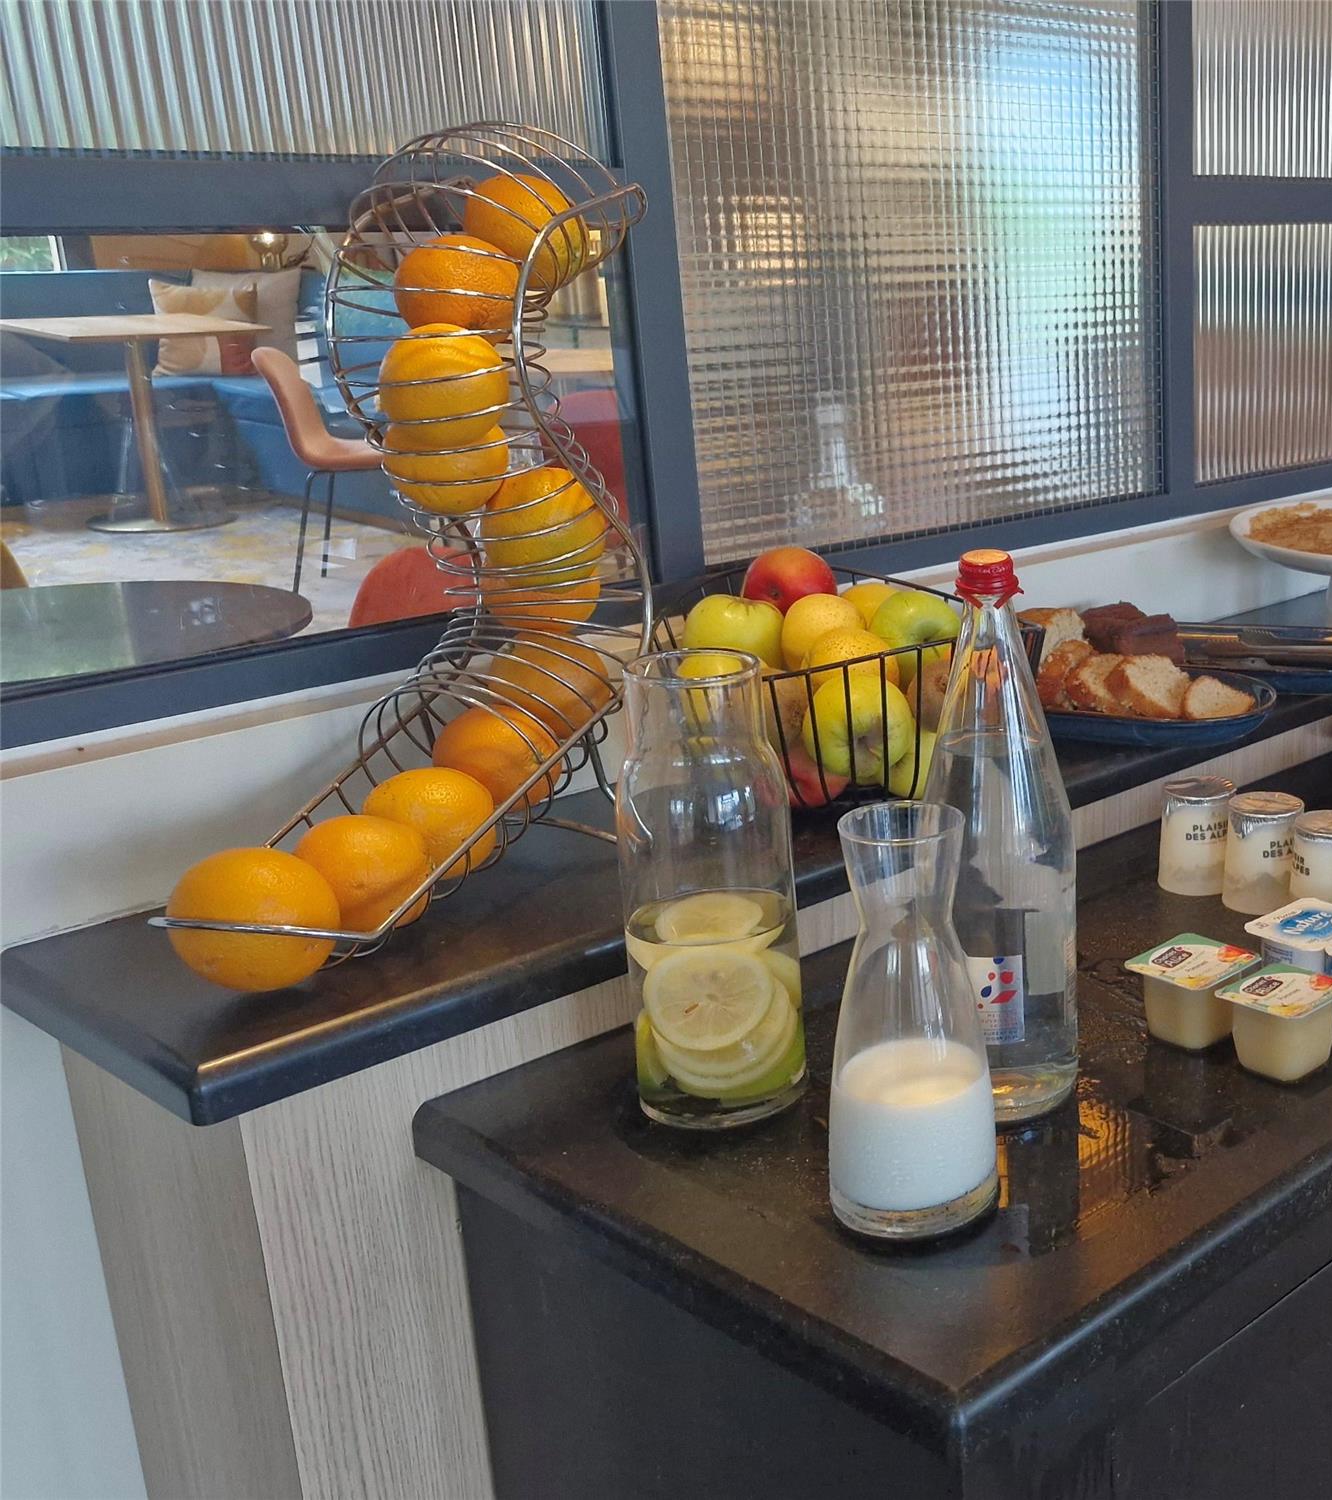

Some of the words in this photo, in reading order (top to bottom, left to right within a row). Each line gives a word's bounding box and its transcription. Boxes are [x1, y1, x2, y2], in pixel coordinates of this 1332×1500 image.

[1186, 833, 1206, 841] DES
[1210, 828, 1228, 840] ALP
[1270, 837, 1294, 849] PLAI
[1263, 849, 1283, 858] DES
[1283, 911, 1332, 935] Nature
